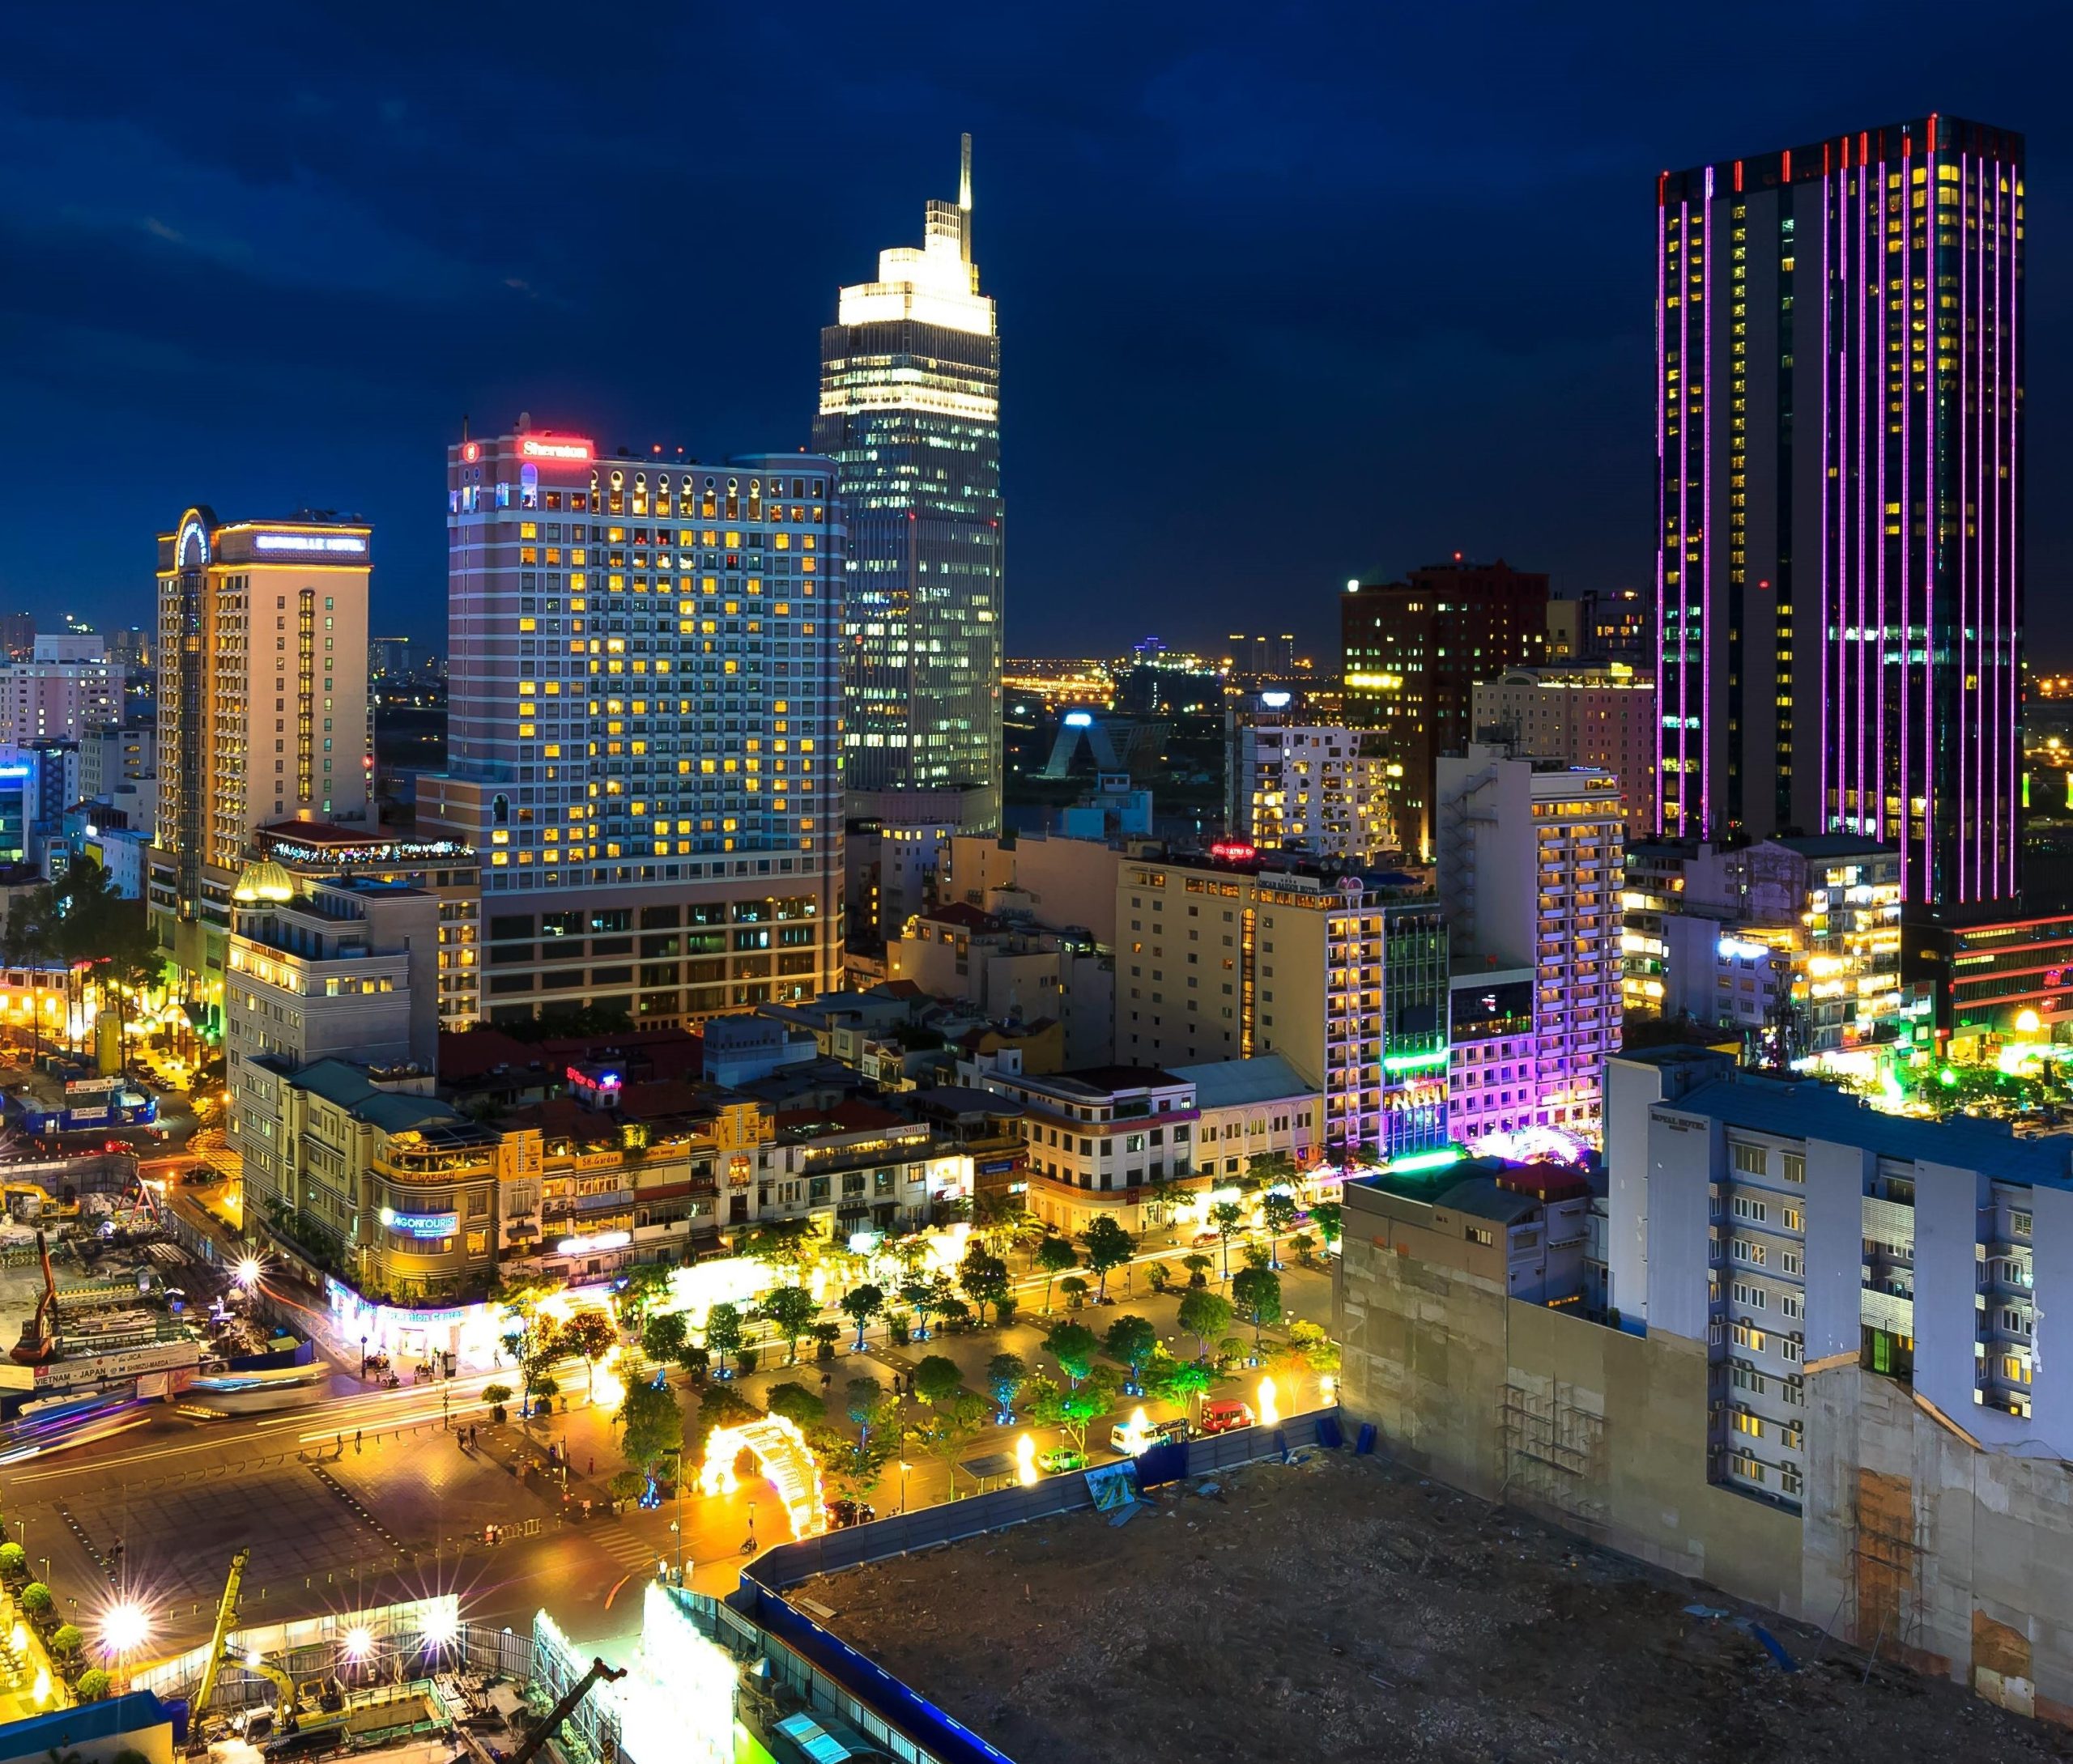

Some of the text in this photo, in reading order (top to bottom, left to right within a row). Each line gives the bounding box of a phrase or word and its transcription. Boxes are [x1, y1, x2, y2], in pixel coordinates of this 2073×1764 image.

[127, 1353, 142, 1361] JICA
[35, 1374, 70, 1386] VIETNAM
[79, 1367, 106, 1379] JAPAN
